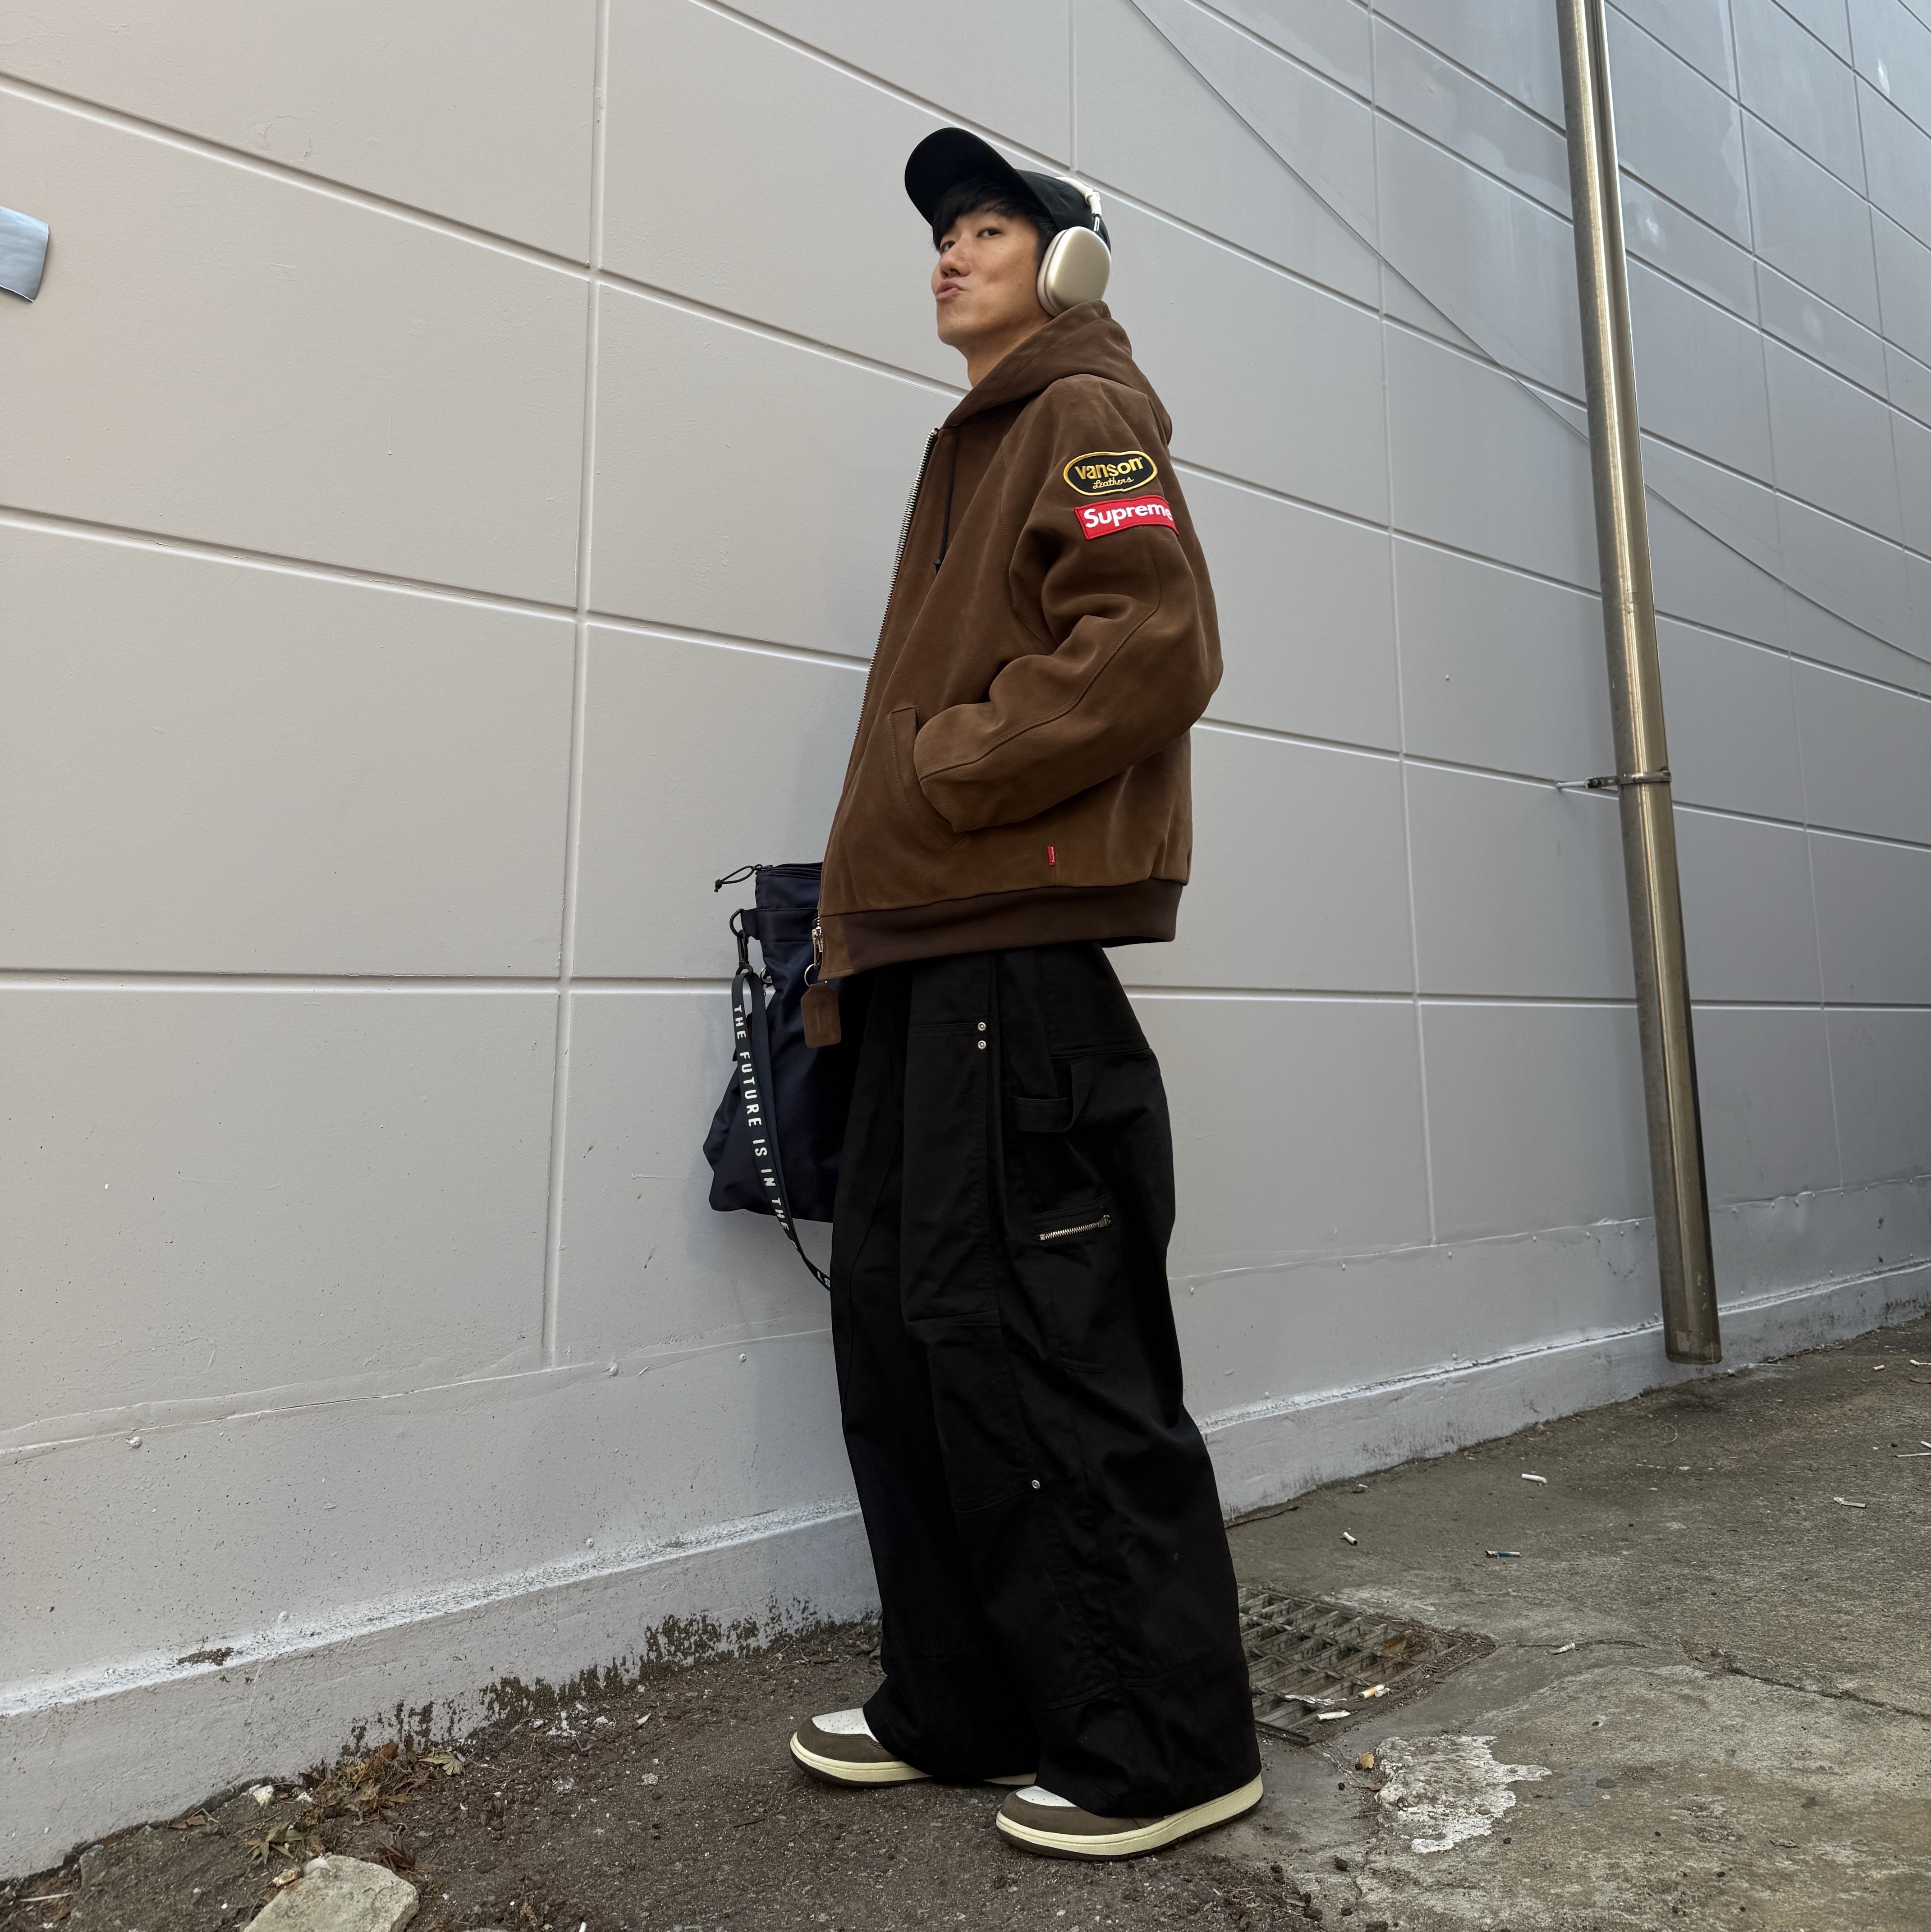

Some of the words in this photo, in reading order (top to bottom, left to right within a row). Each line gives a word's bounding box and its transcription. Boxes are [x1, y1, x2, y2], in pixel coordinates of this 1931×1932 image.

[1092, 477, 1134, 489] Leathers
[1083, 504, 1173, 528] Supreme
[734, 1005, 746, 1039] THE
[739, 1051, 762, 1127] FUTURE
[752, 1139, 767, 1156] IS
[761, 1169, 776, 1186] IN
[771, 1198, 789, 1230] THE
